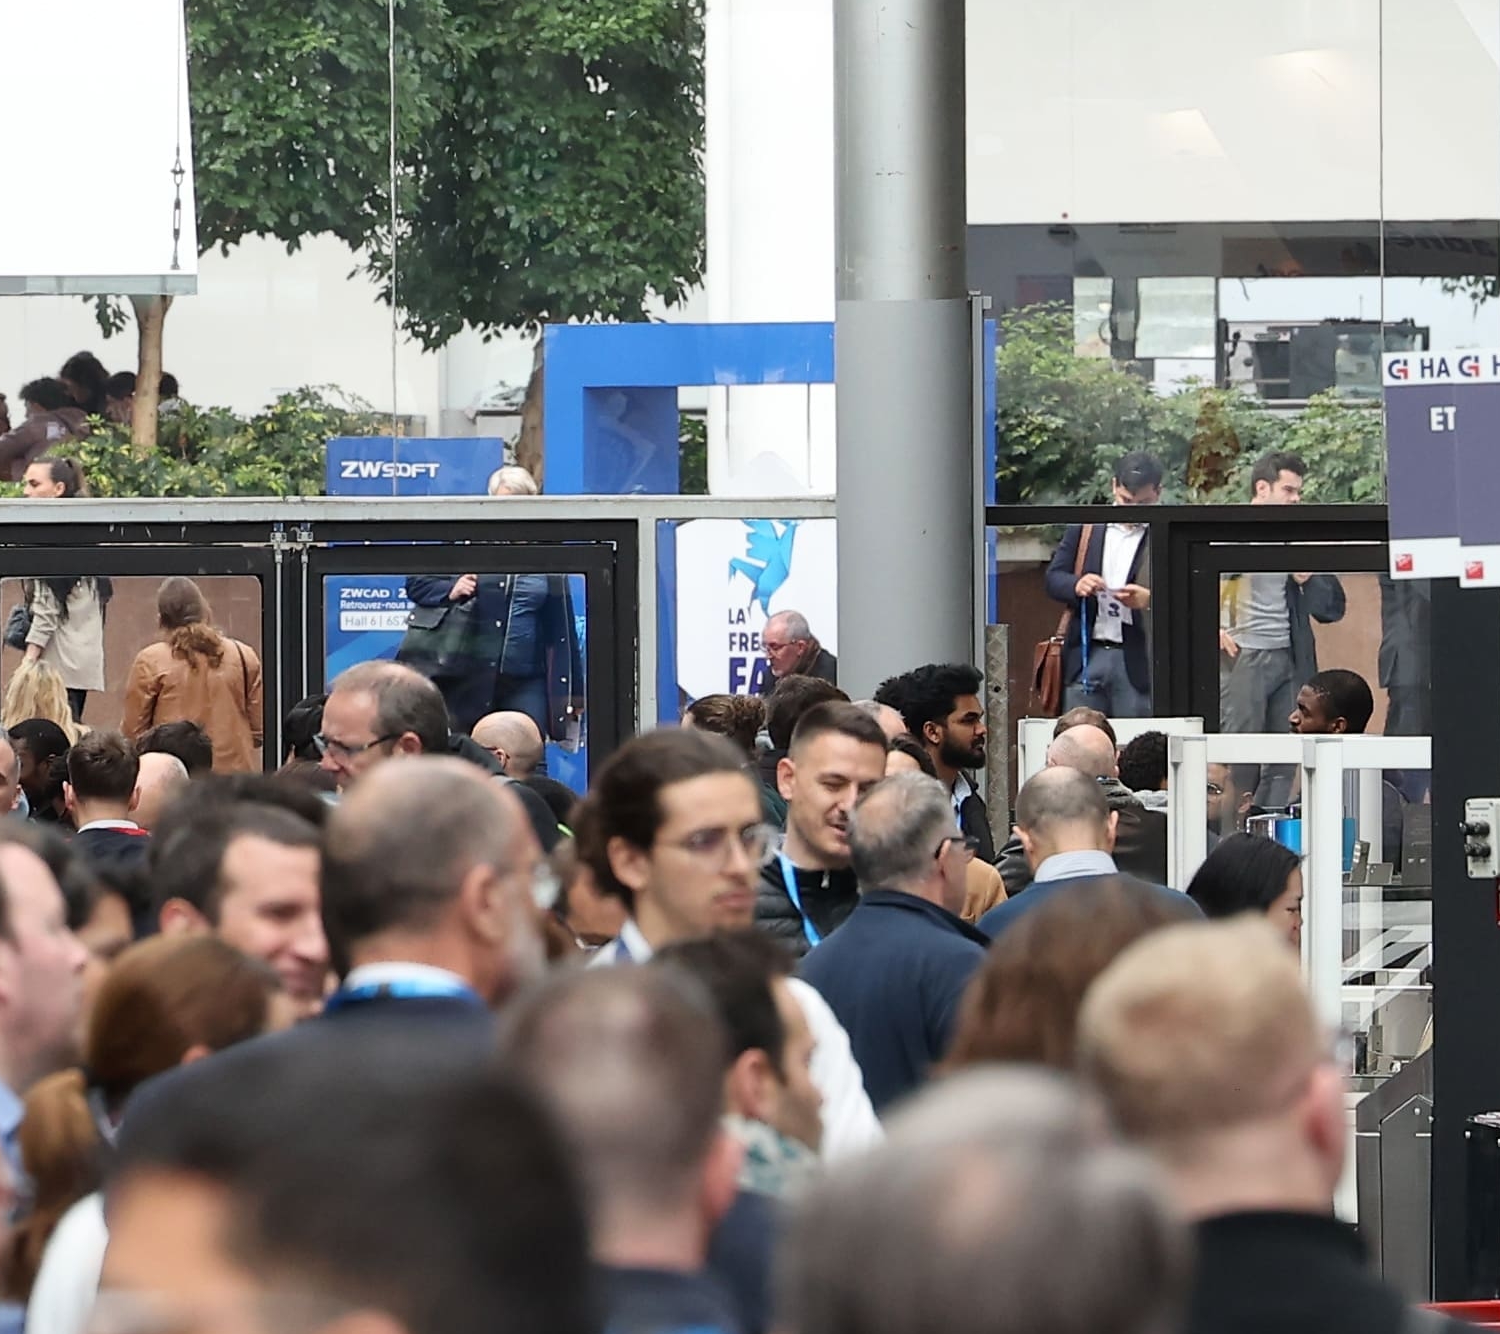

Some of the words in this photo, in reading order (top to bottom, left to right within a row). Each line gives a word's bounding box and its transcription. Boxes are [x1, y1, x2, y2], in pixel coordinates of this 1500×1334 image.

[1420, 358, 1450, 378] HA
[1430, 406, 1456, 432] ET
[341, 461, 440, 478] ZWSOFT
[341, 588, 390, 598] ZWCAD
[340, 602, 405, 610] Retrouvez-nous
[345, 616, 367, 626] Hall
[371, 617, 376, 626] 6
[729, 608, 746, 624] LA
[729, 632, 760, 651] FRE
